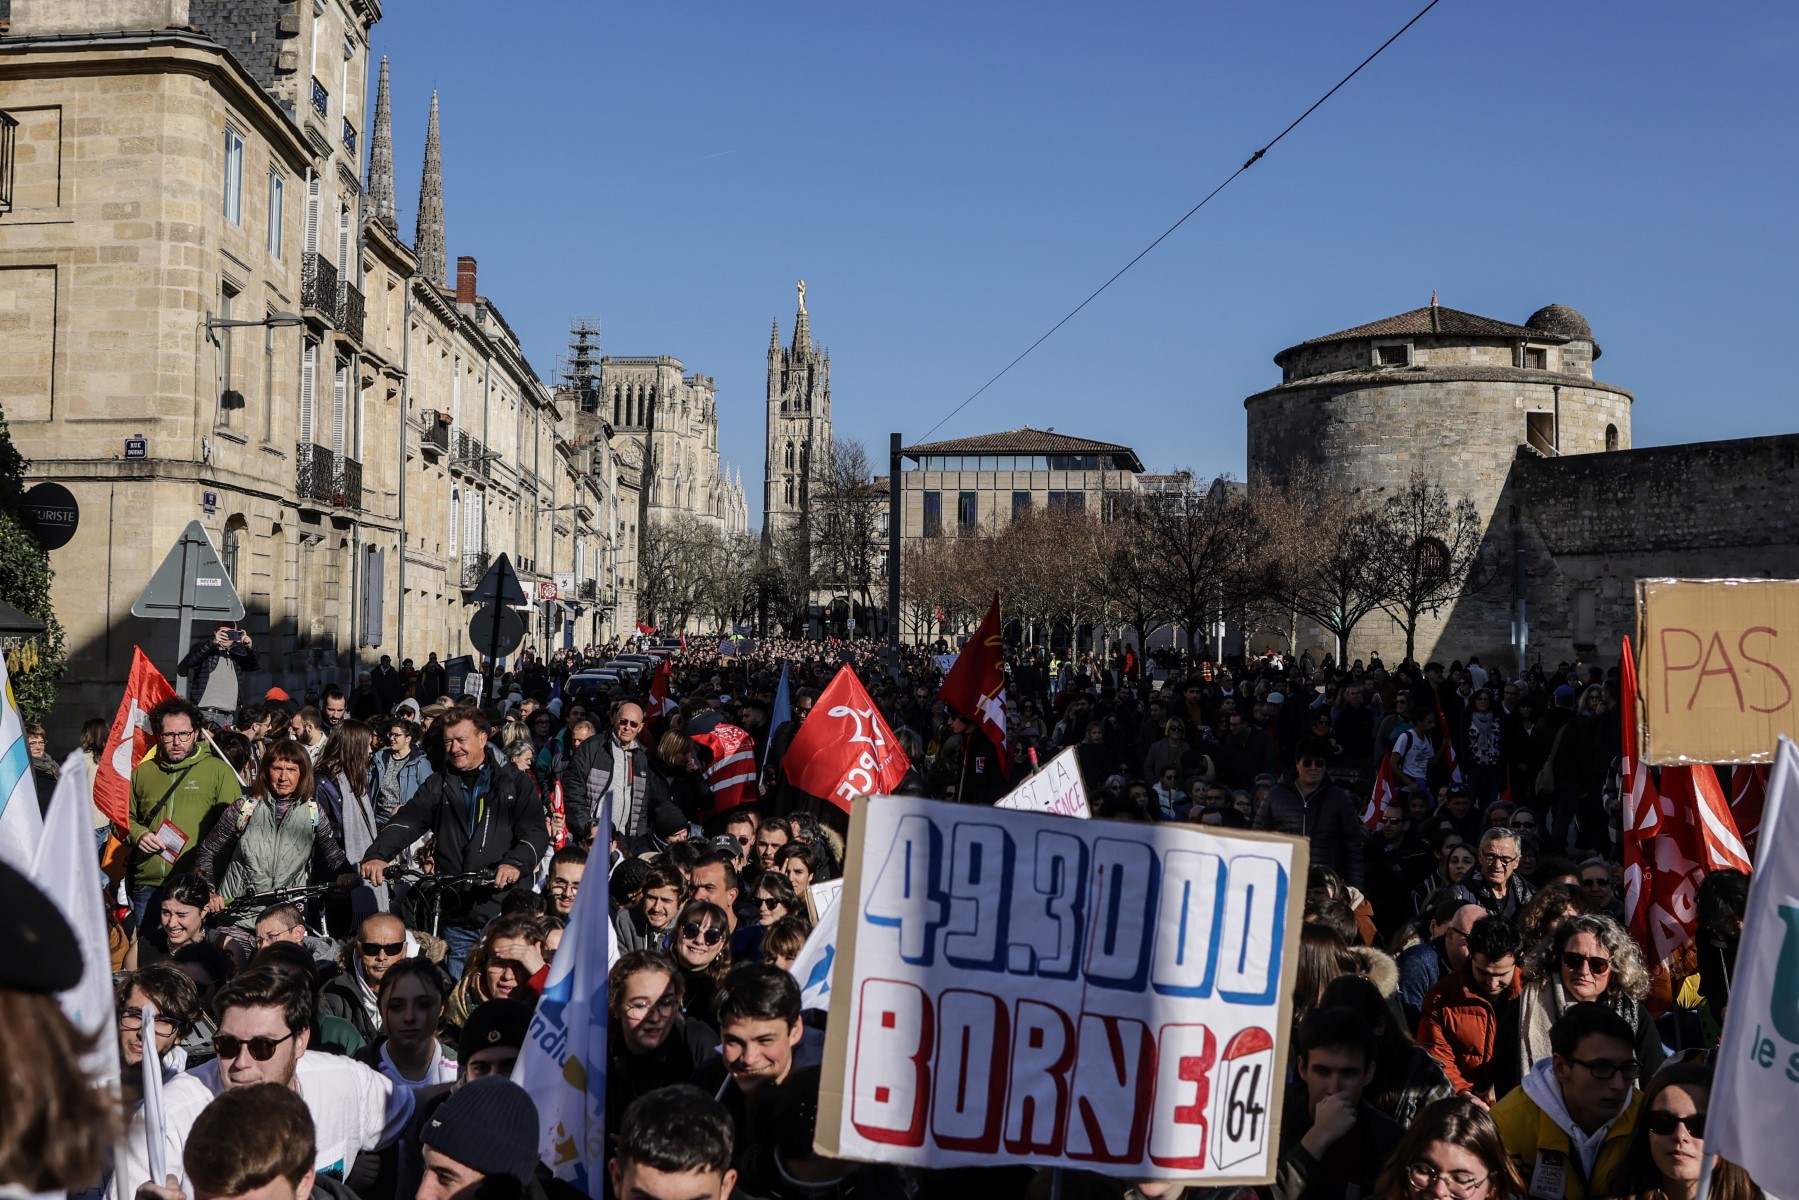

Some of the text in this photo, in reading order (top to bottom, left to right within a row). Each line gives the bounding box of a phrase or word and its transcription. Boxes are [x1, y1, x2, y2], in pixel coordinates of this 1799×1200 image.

[33, 509, 75, 522] URISTE
[1660, 626, 1793, 714] PAS
[1045, 761, 1071, 794] LA
[865, 814, 1289, 1006] 49.3000
[851, 977, 1216, 1171] BORNE
[1750, 1024, 1776, 1069] le
[1227, 1063, 1264, 1143] 64
